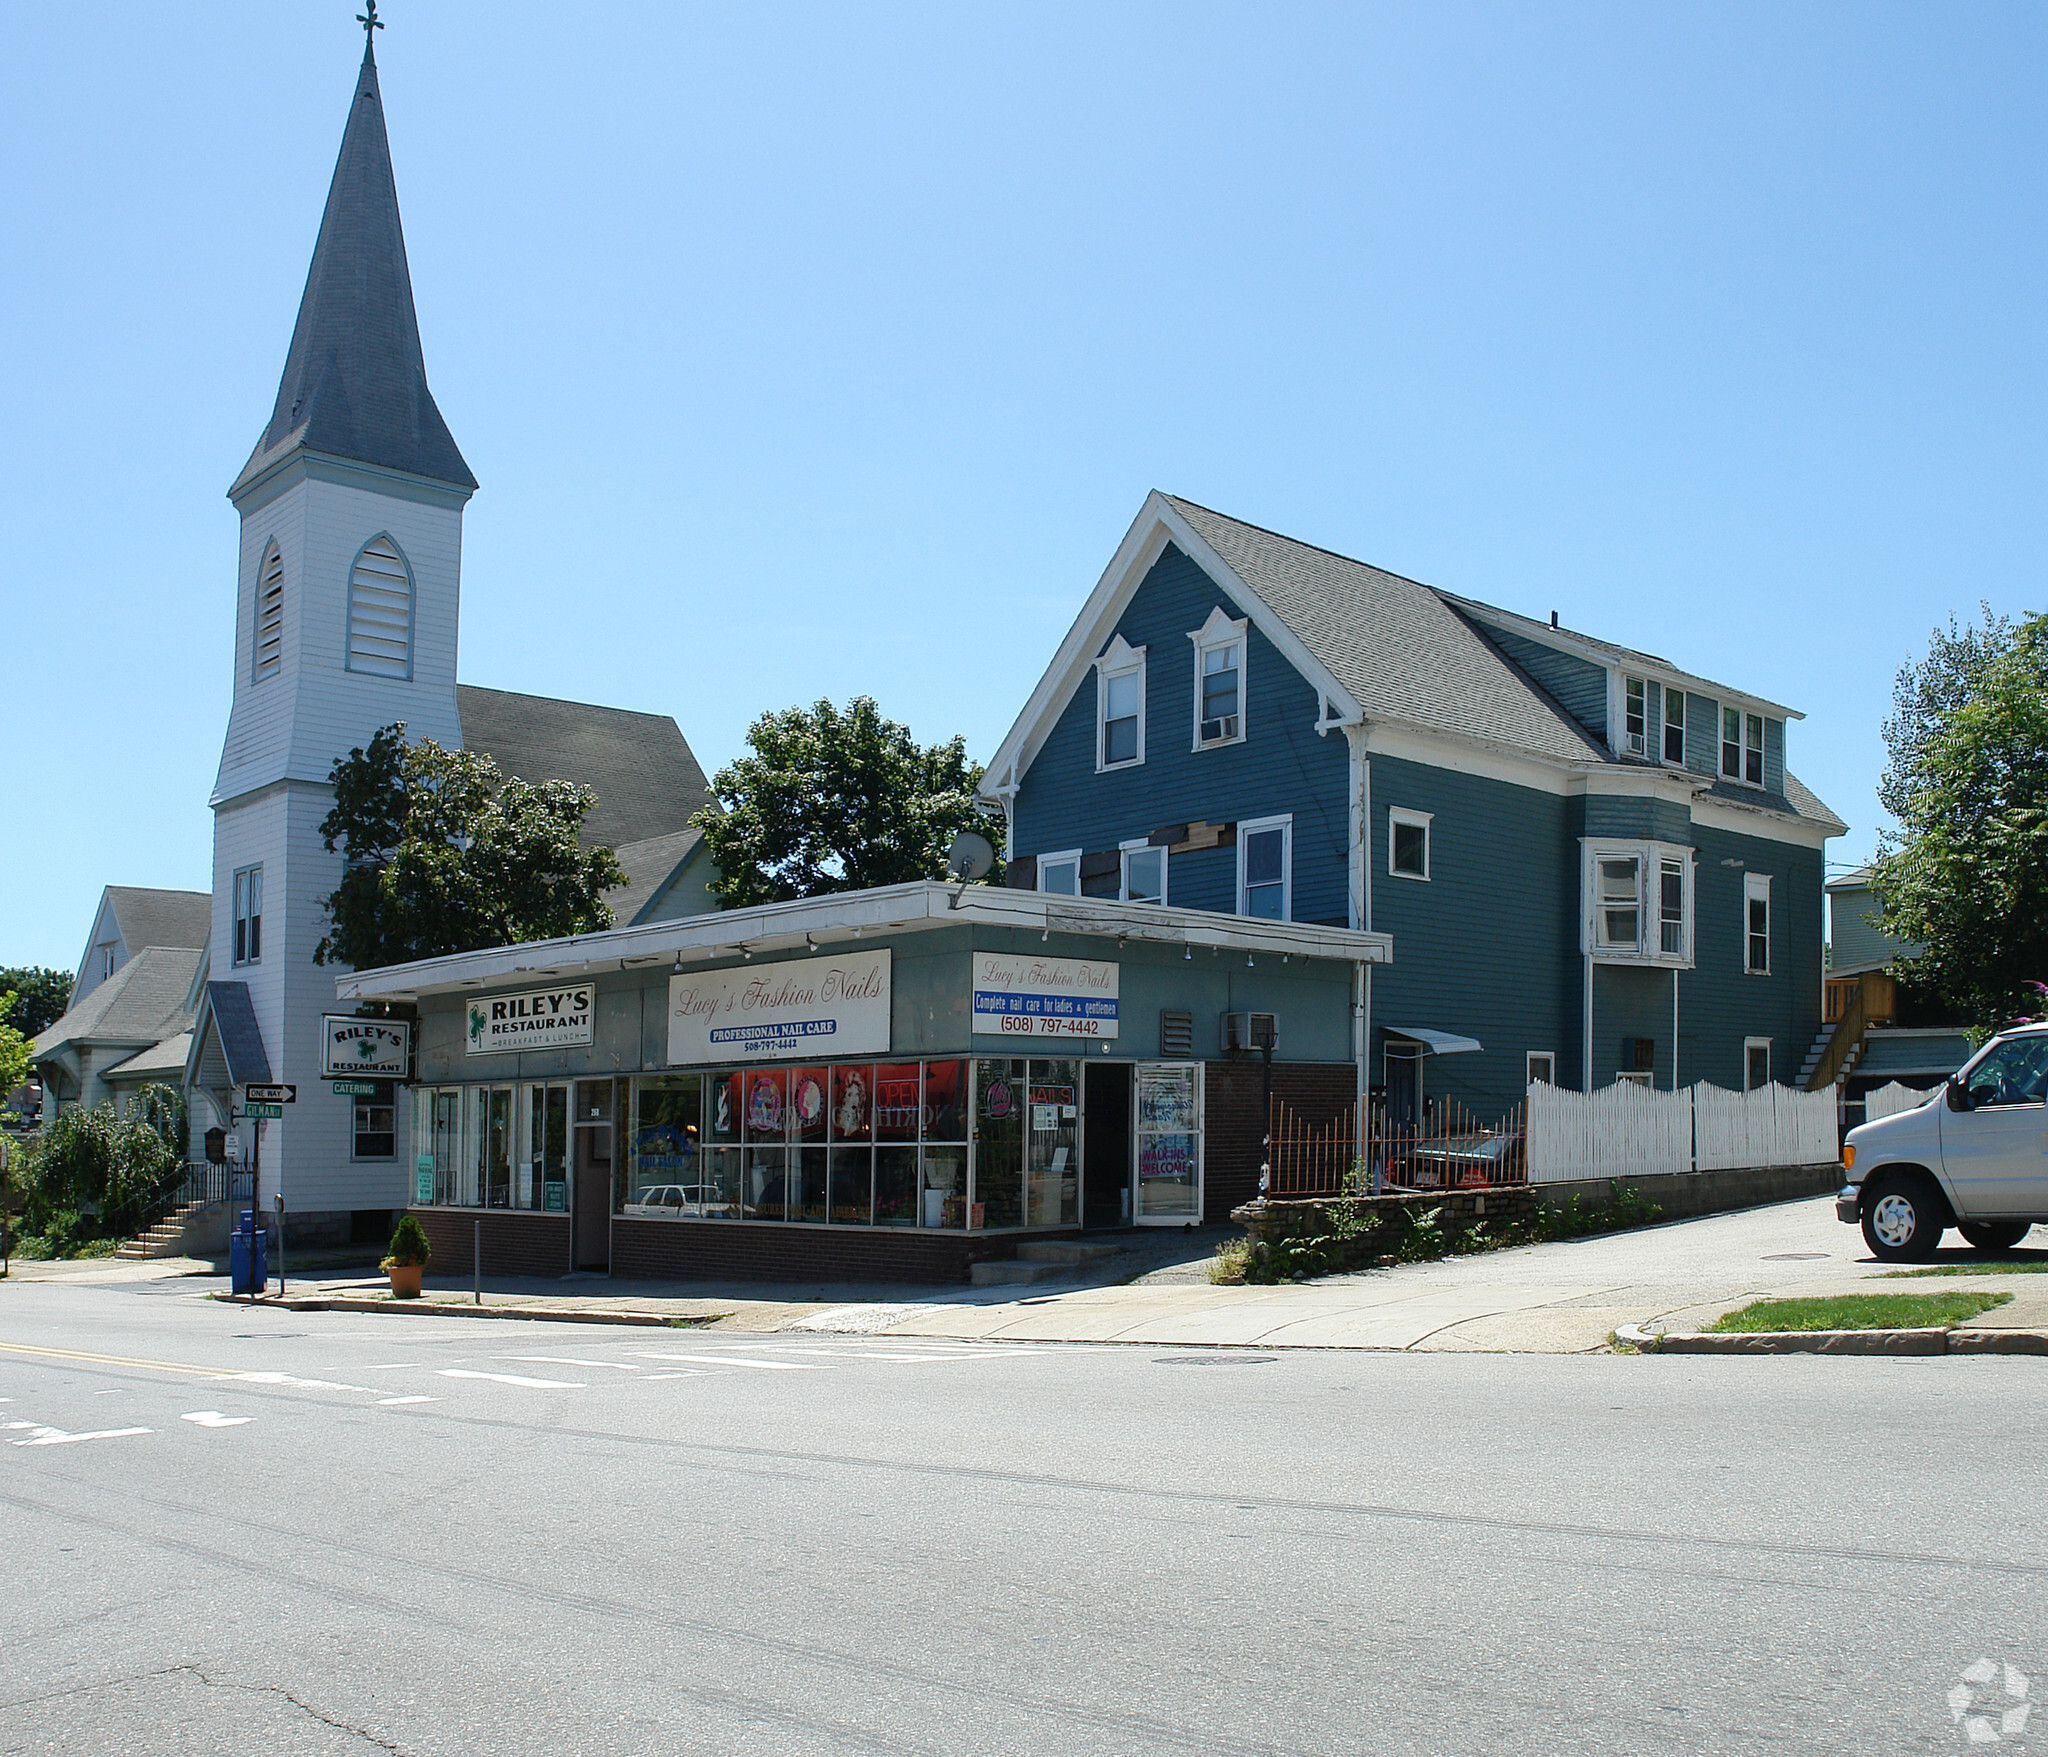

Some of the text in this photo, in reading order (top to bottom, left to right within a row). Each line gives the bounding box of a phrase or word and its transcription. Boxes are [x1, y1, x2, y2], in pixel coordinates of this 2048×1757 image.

[981, 960, 1111, 991] Lucy's Fashion Nails
[674, 965, 885, 1026] Lucy's Fashion Nails
[976, 993, 1006, 1014] Complete
[1009, 996, 1023, 1011] nail
[1026, 1000, 1040, 1012] care
[1043, 998, 1054, 1012] for
[1054, 998, 1073, 1014] ladies
[1085, 1000, 1116, 1018] gentlemen
[491, 991, 589, 1021] RILEY'S
[491, 1014, 589, 1034] RESTAURANT
[712, 1021, 834, 1042] PROFESSIONAL NAIL CARE
[1001, 1015, 1099, 1035] (508) 797-4442
[334, 1026, 402, 1047] RILEY'S
[498, 1037, 543, 1047] BREAKFAST
[552, 1033, 580, 1042] LUNCH
[744, 1039, 797, 1052] 508-797-4442
[332, 1062, 401, 1072] RESTAURANT
[250, 1089, 282, 1097] ONE WAY
[334, 1083, 374, 1094] CATERING
[876, 1082, 920, 1108] OPEN
[246, 1104, 275, 1117] GILMAN
[1142, 1147, 1186, 1161] WALK-INS
[1142, 1161, 1187, 1174] WELCOME
